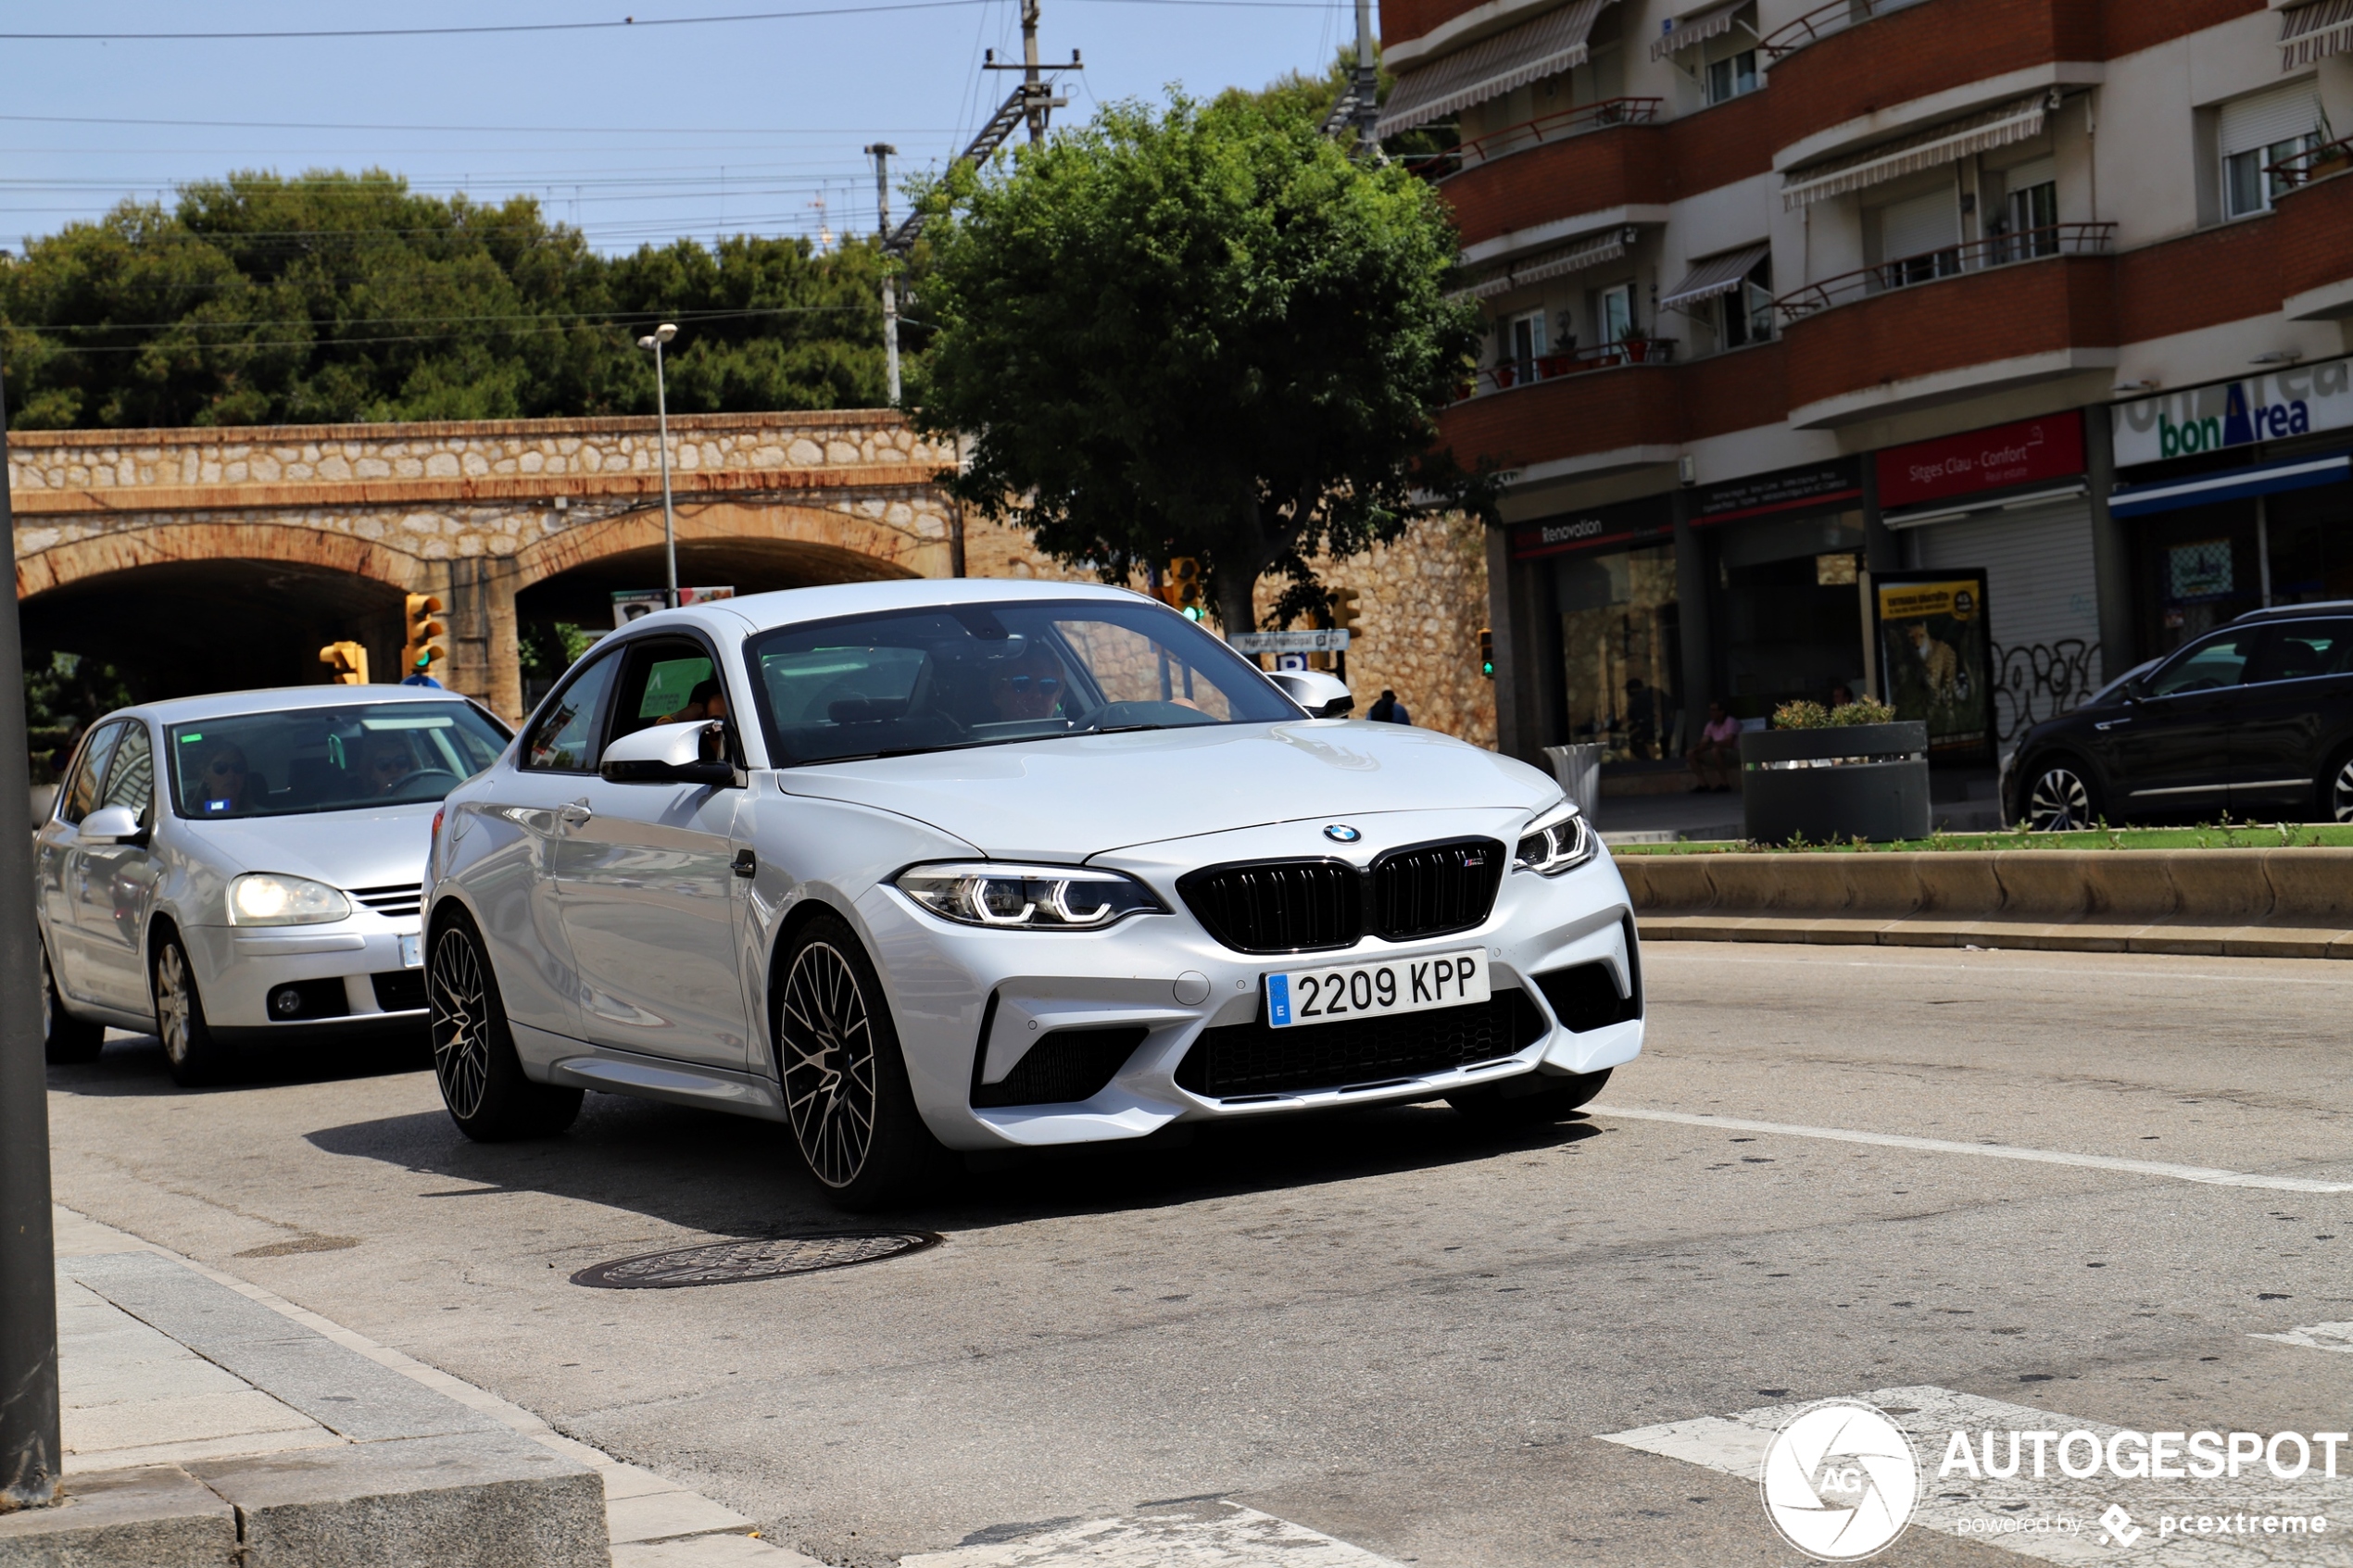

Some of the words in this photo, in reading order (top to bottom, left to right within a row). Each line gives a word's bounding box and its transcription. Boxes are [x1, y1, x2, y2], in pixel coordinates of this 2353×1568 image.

[2159, 382, 2309, 458] bonArea
[1908, 463, 1944, 484] Sitges
[1944, 458, 1972, 474] Clau
[1981, 445, 2028, 468] Confort
[1541, 519, 1603, 544] Renovation
[1244, 636, 1272, 647] Mercat
[1275, 634, 1312, 647] Municipal
[1276, 1005, 1285, 1017] E
[1298, 967, 1397, 1018] 2209
[1410, 956, 1476, 1004] KPP
